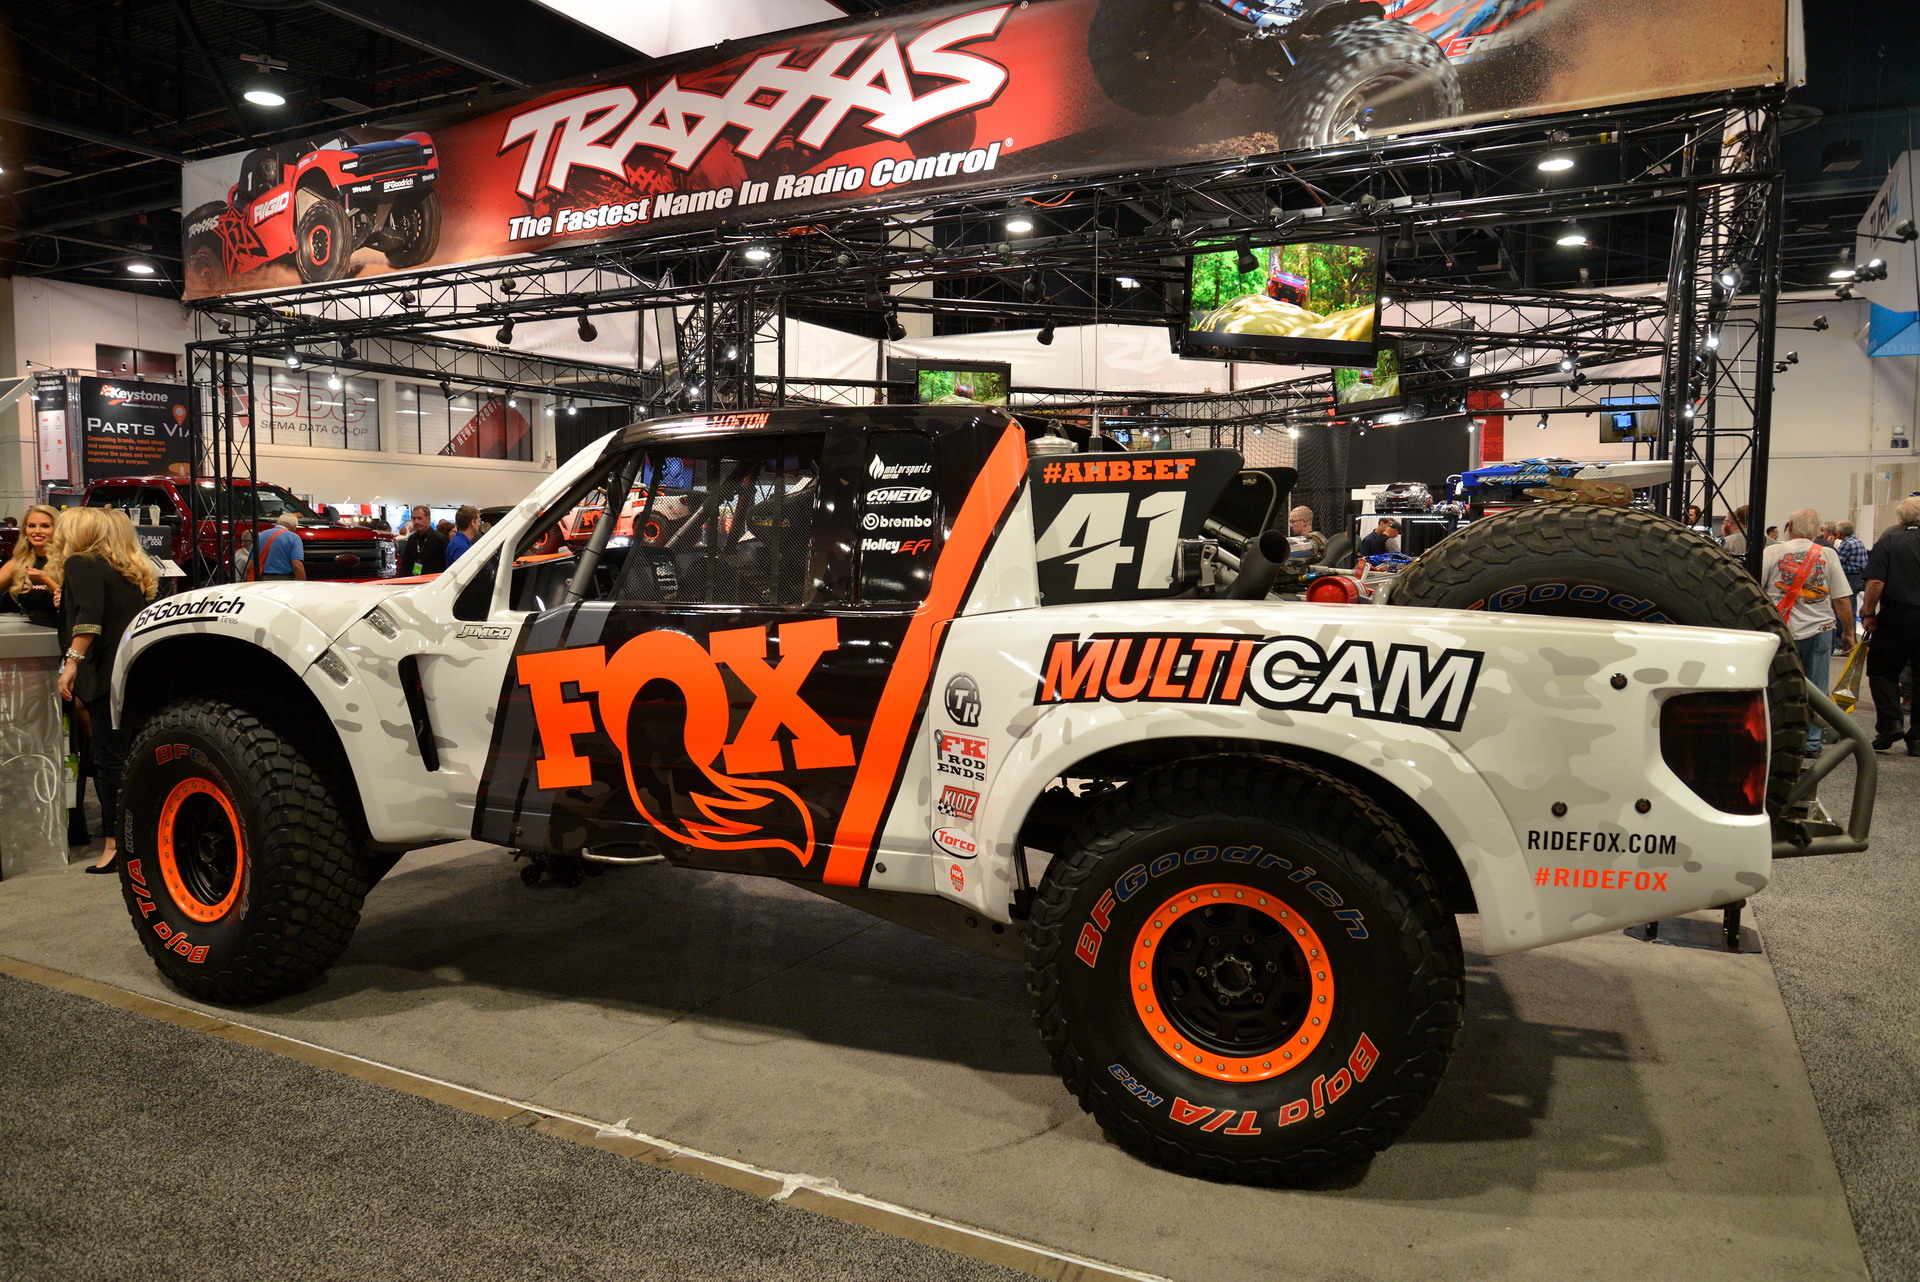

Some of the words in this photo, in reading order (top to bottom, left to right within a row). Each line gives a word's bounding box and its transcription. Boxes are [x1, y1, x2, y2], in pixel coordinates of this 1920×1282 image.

[500, 4, 1012, 197] TRAXXAS
[247, 171, 253, 192] 1
[384, 178, 413, 190] BFGoodrich
[509, 216, 551, 241] The
[555, 199, 650, 234] Fastest
[653, 188, 733, 218] Name
[738, 181, 769, 205] In
[774, 165, 864, 200] Radio
[870, 142, 1002, 187] Control
[254, 190, 289, 225] RIGID
[111, 387, 168, 402] Keystone
[261, 383, 367, 423] SDC
[87, 417, 155, 436] PARTS
[261, 420, 295, 431] SEMA
[299, 423, 328, 433] DATA
[332, 426, 368, 436] CO-OP
[457, 423, 476, 445] HERE
[884, 462, 932, 476] motorsports
[1043, 458, 1196, 484] #AHBEEF
[866, 486, 932, 503] COMETIC
[880, 514, 932, 528] brembo
[861, 538, 900, 554] Holley
[1035, 490, 1187, 590] 41
[135, 596, 245, 630] BFGoodrich
[220, 615, 239, 625] Tires
[456, 624, 512, 639] JIMCO
[1036, 634, 1481, 728] MULTICAM
[516, 618, 856, 867] FOX
[941, 734, 986, 760] FK
[937, 762, 985, 782] ENDS
[948, 754, 986, 770] ROD
[944, 789, 977, 814] KLOTZ
[938, 829, 976, 853] Torco
[1528, 830, 1677, 855] RIDEFOX.COM
[127, 859, 156, 919] T/A
[1534, 867, 1668, 892] #RIDEFOX
[1074, 845, 1369, 969] BFGoodrich
[153, 921, 210, 963] Baja
[1108, 1063, 1163, 1108] KR3
[1278, 1032, 1380, 1127] Baja
[1169, 1096, 1262, 1136] T/A
